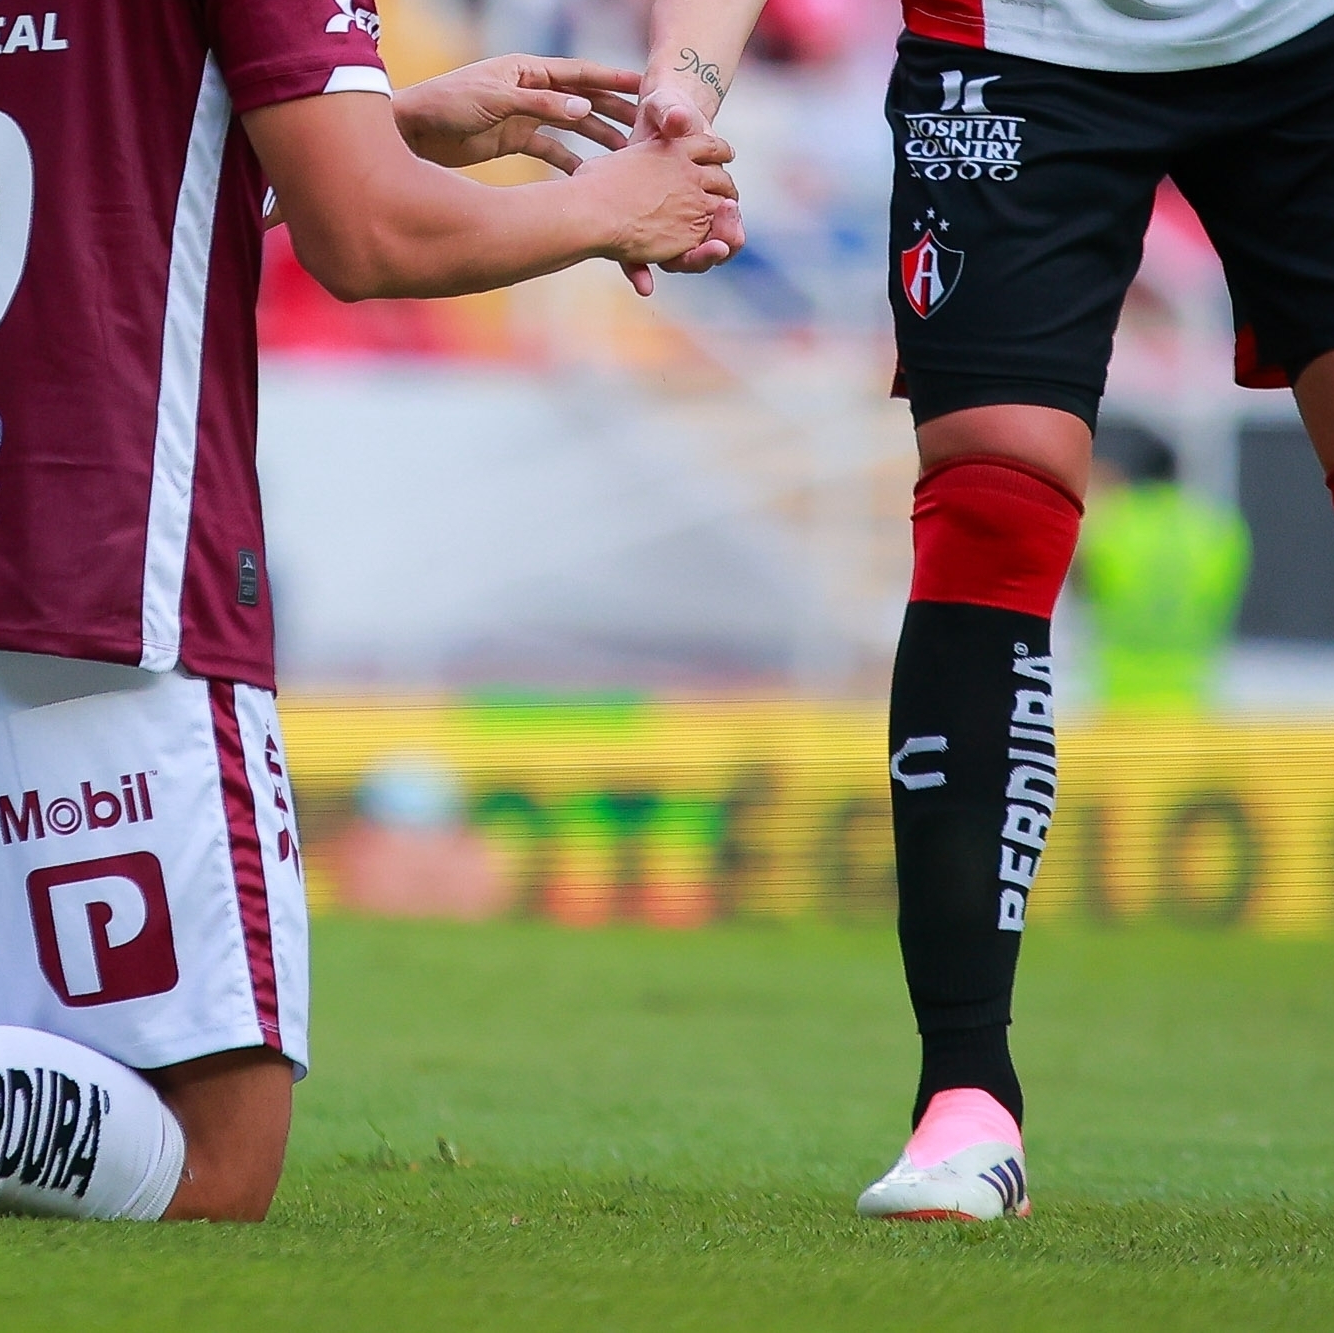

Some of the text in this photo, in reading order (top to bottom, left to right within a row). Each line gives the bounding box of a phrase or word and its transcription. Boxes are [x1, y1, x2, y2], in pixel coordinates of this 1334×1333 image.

[907, 119, 1022, 141] HOSPITAL
[905, 138, 1022, 160] COUNTRY
[997, 654, 1057, 932] PERDURA
